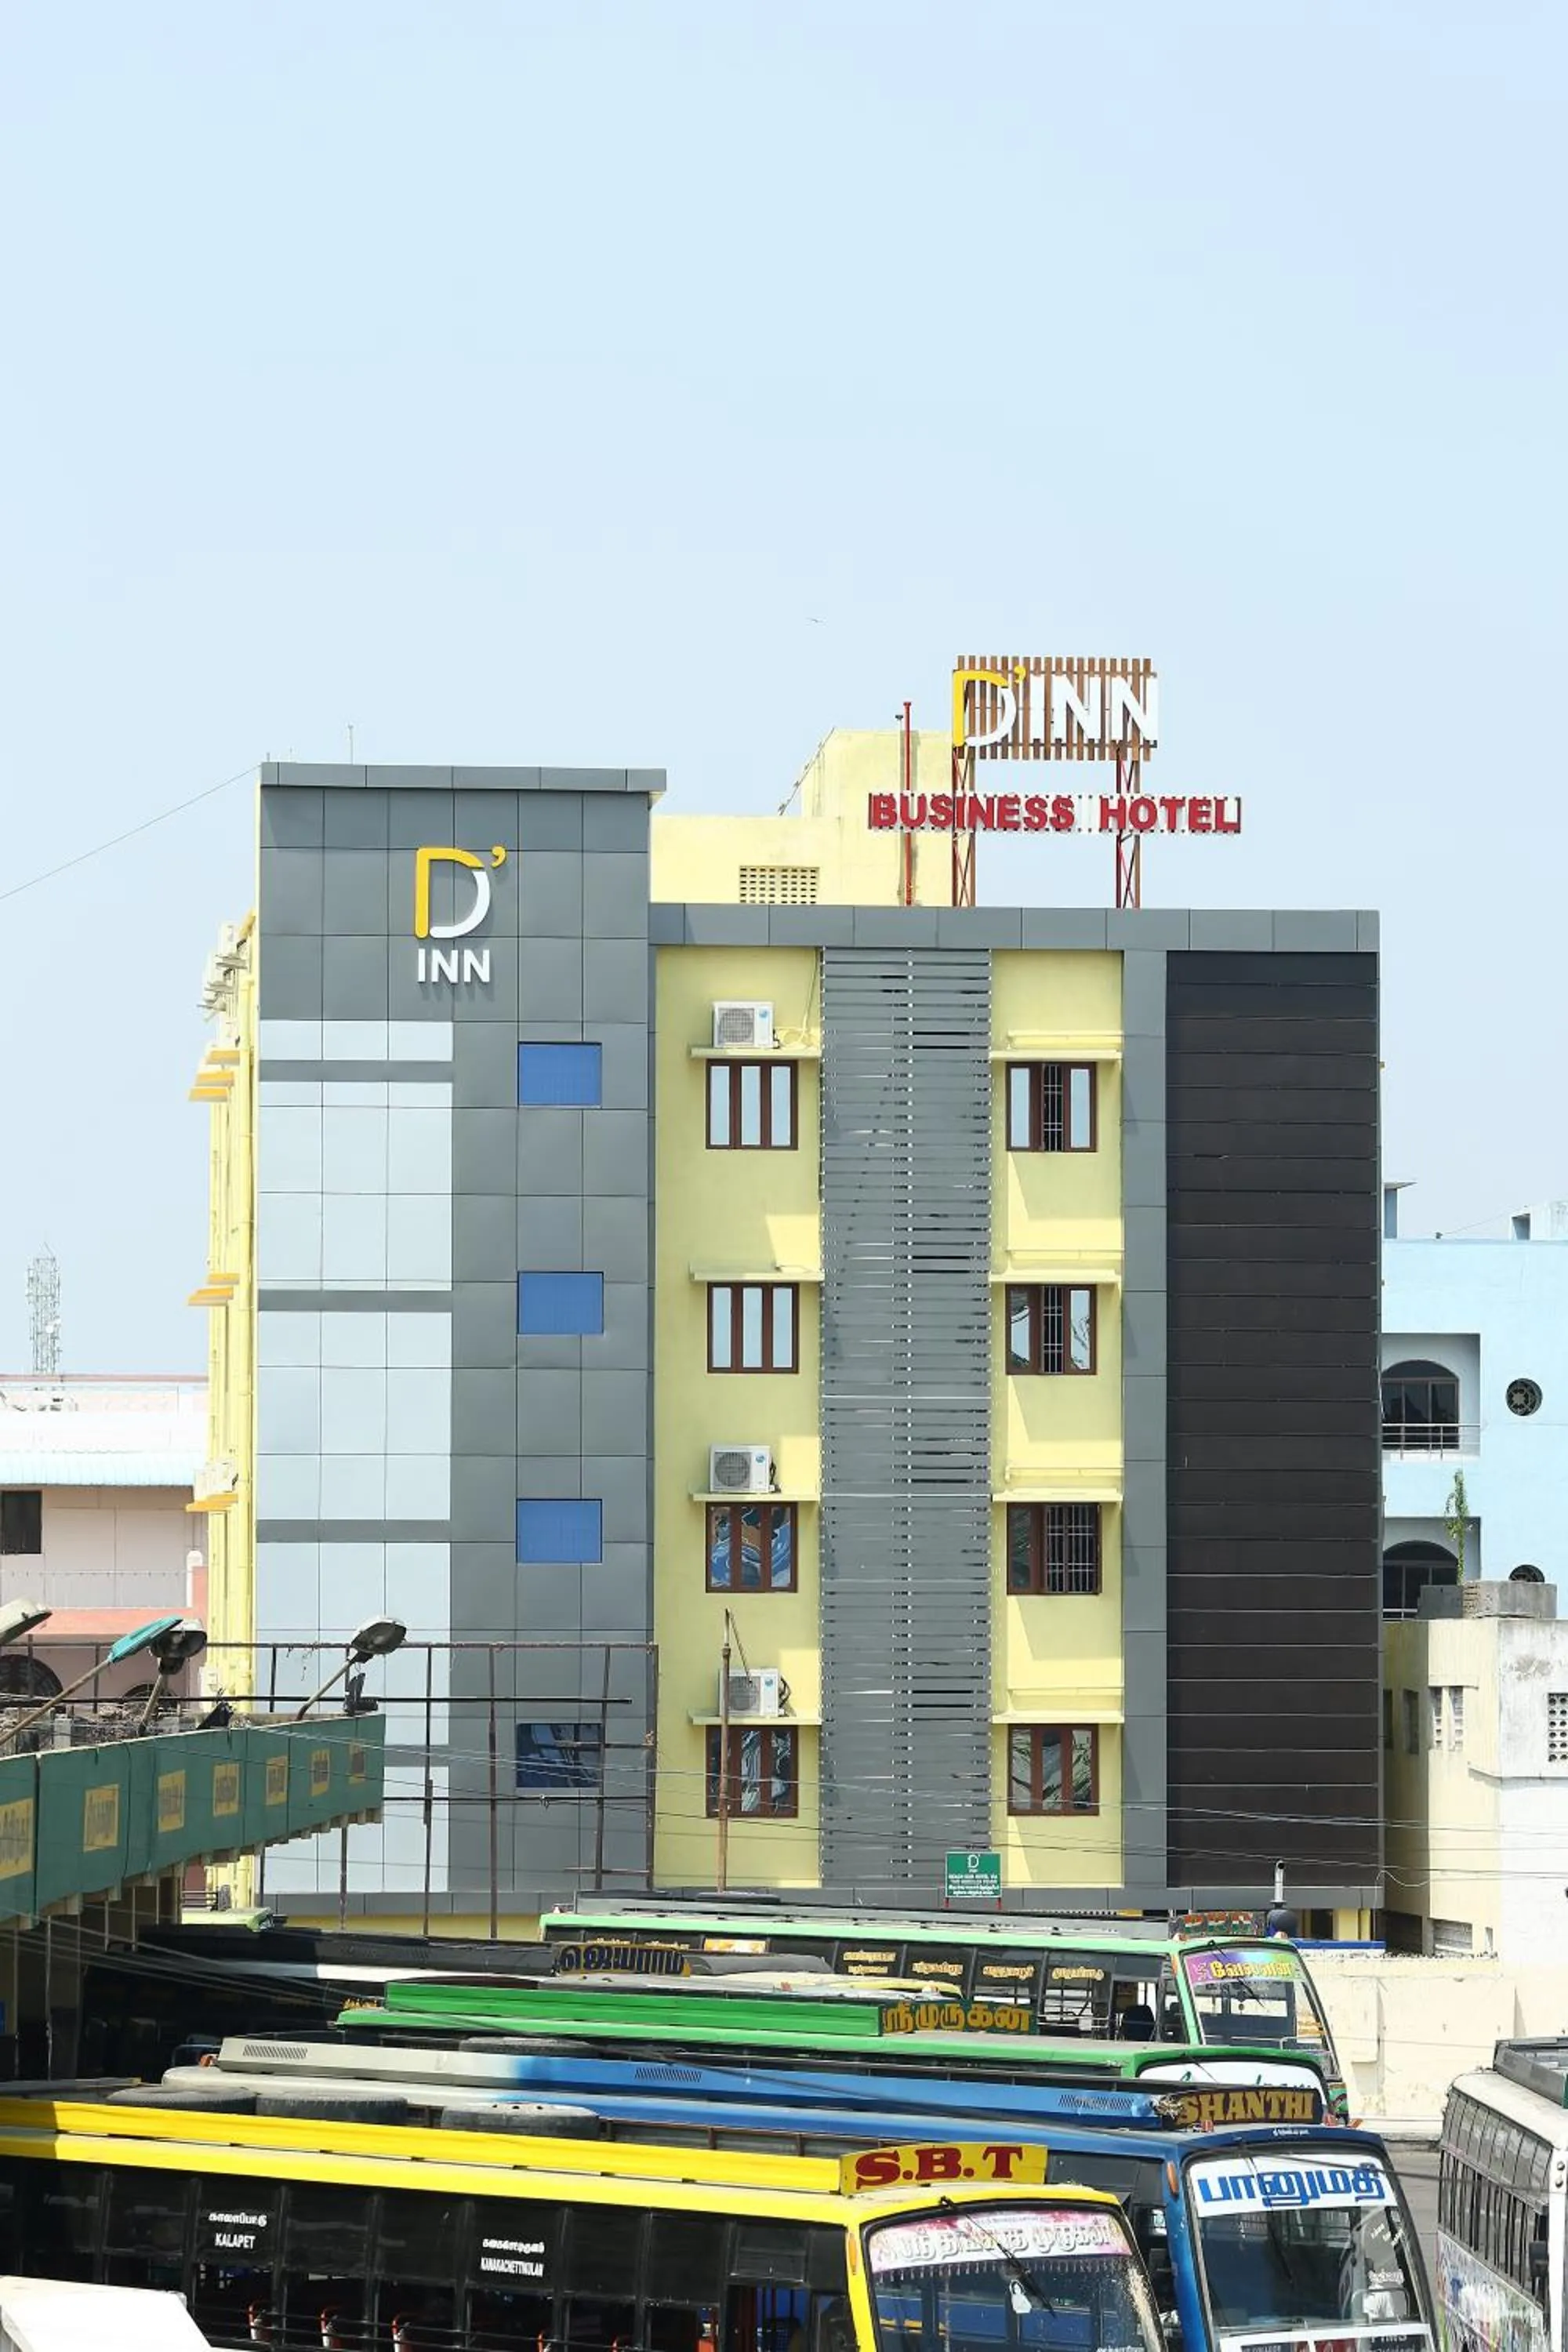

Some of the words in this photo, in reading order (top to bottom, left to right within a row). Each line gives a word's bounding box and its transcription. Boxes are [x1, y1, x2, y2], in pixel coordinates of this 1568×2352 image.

[871, 794, 1075, 831] BUSINESS
[1099, 796, 1239, 831] HOTEL
[417, 948, 491, 983] INN
[1176, 2091, 1314, 2125] SHANTHI
[214, 2232, 256, 2249] KALAPET
